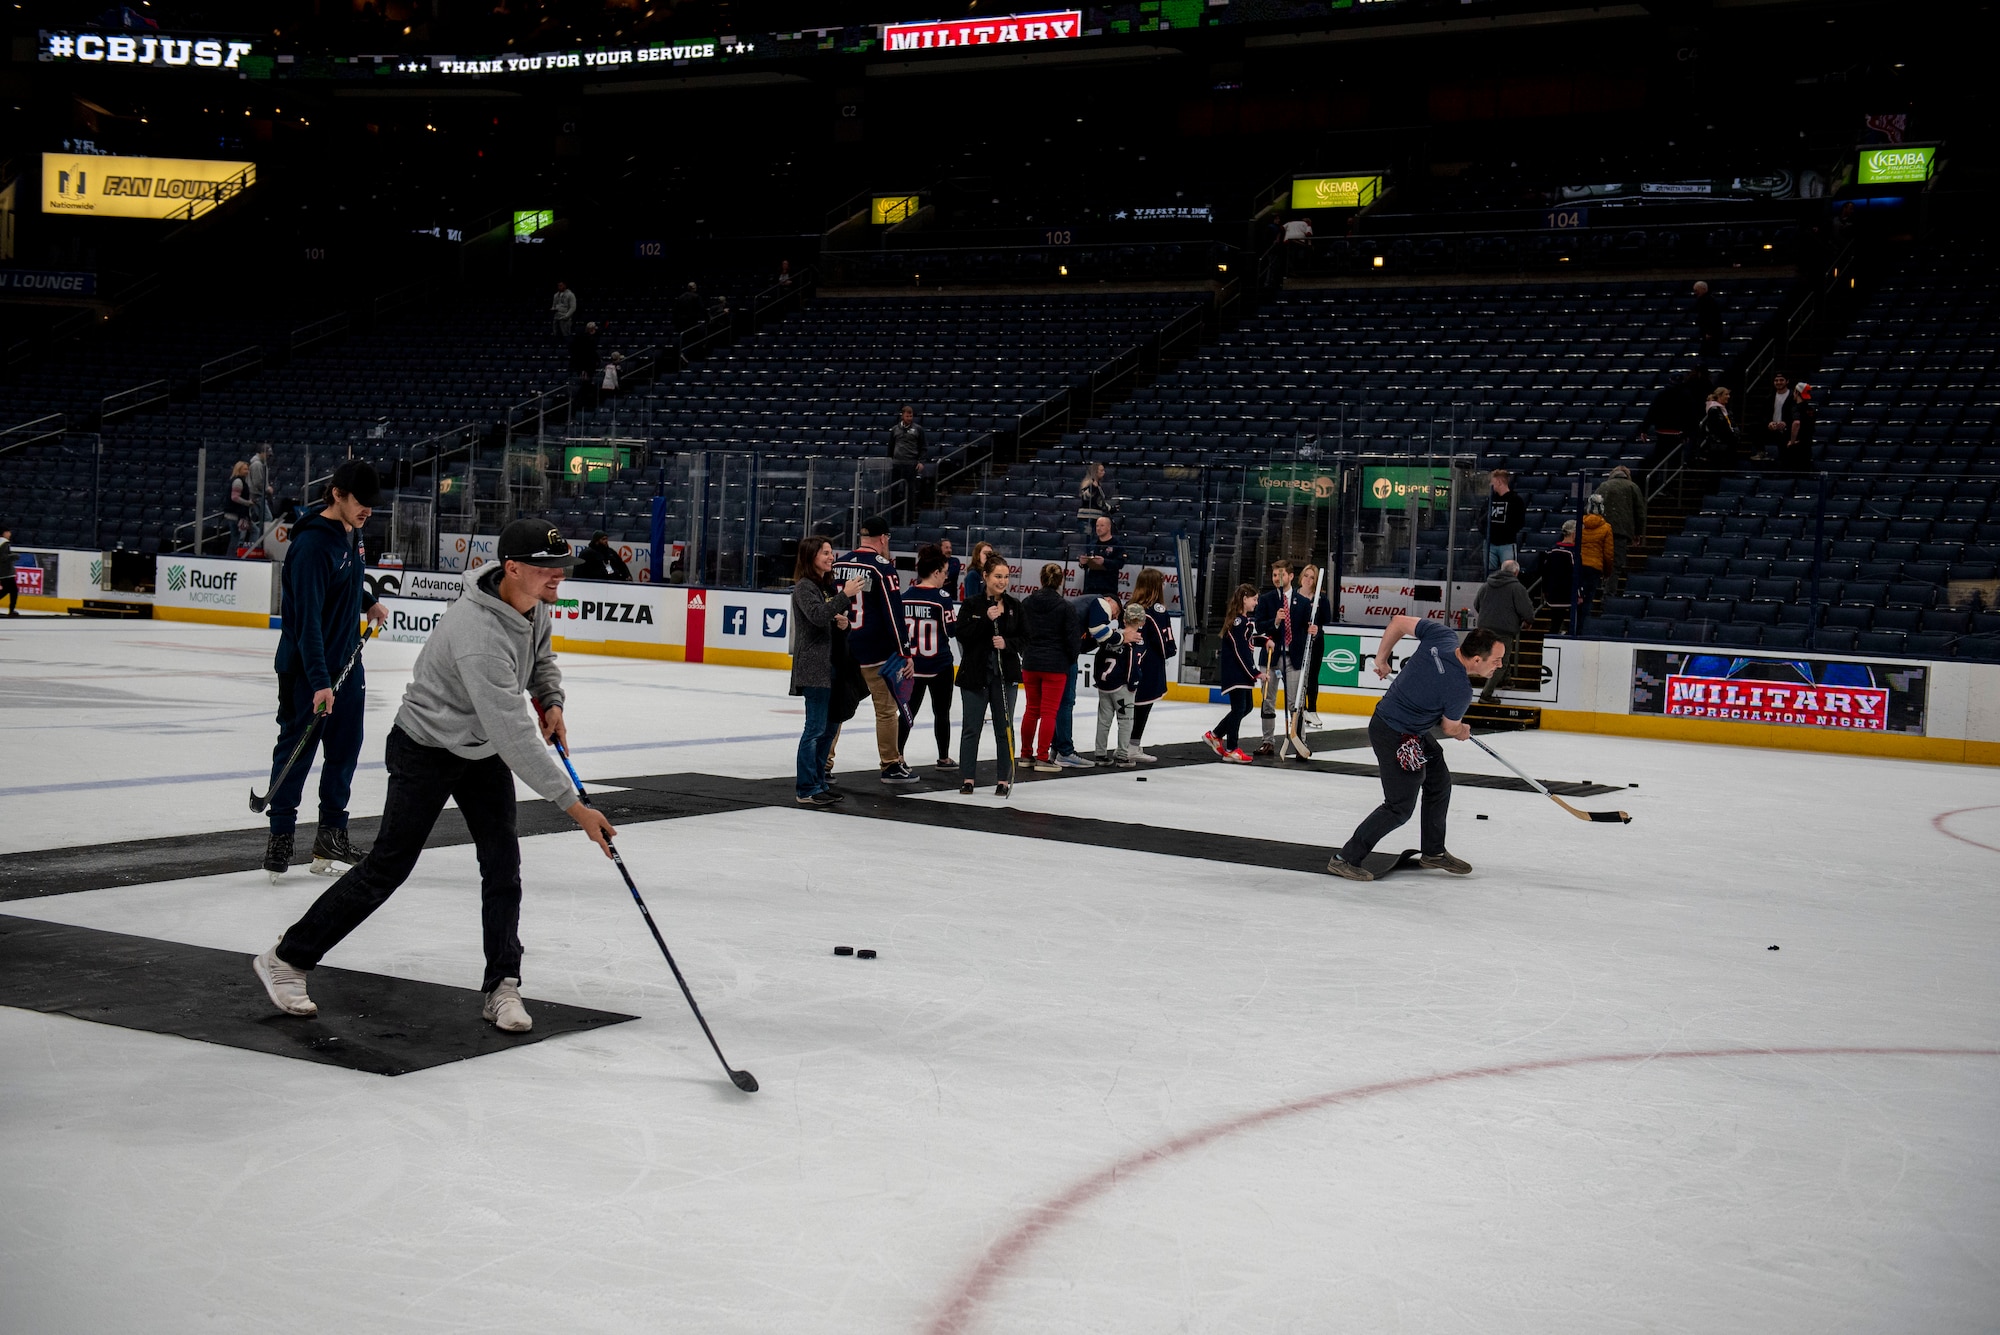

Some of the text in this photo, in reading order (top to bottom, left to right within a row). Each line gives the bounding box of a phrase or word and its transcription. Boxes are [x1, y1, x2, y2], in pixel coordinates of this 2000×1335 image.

[891, 20, 1075, 50] MILITARY
[440, 43, 715, 74] THANK YOU FOR YOUR SERVICE
[1879, 152, 1925, 166] KEMBA
[103, 176, 153, 197] FAN
[1323, 181, 1359, 193] KEMBA
[50, 201, 94, 211] Nationwide
[1547, 213, 1580, 228] 104
[1045, 231, 1071, 245] 103
[304, 247, 325, 260] 101
[640, 243, 661, 256] 102
[12, 274, 85, 291] LOUNGE
[636, 550, 651, 562] PN
[190, 569, 238, 590] Ruoff
[189, 592, 236, 605] MORTGAGE
[582, 601, 653, 624] PIZZA
[914, 605, 932, 619] WIFE
[1365, 606, 1406, 616] KENDA
[393, 611, 443, 631] Ruof
[1101, 657, 1117, 682] 7
[1672, 681, 1882, 714] MILITARY
[1671, 704, 1881, 728] APPRECIATION NIGHT
